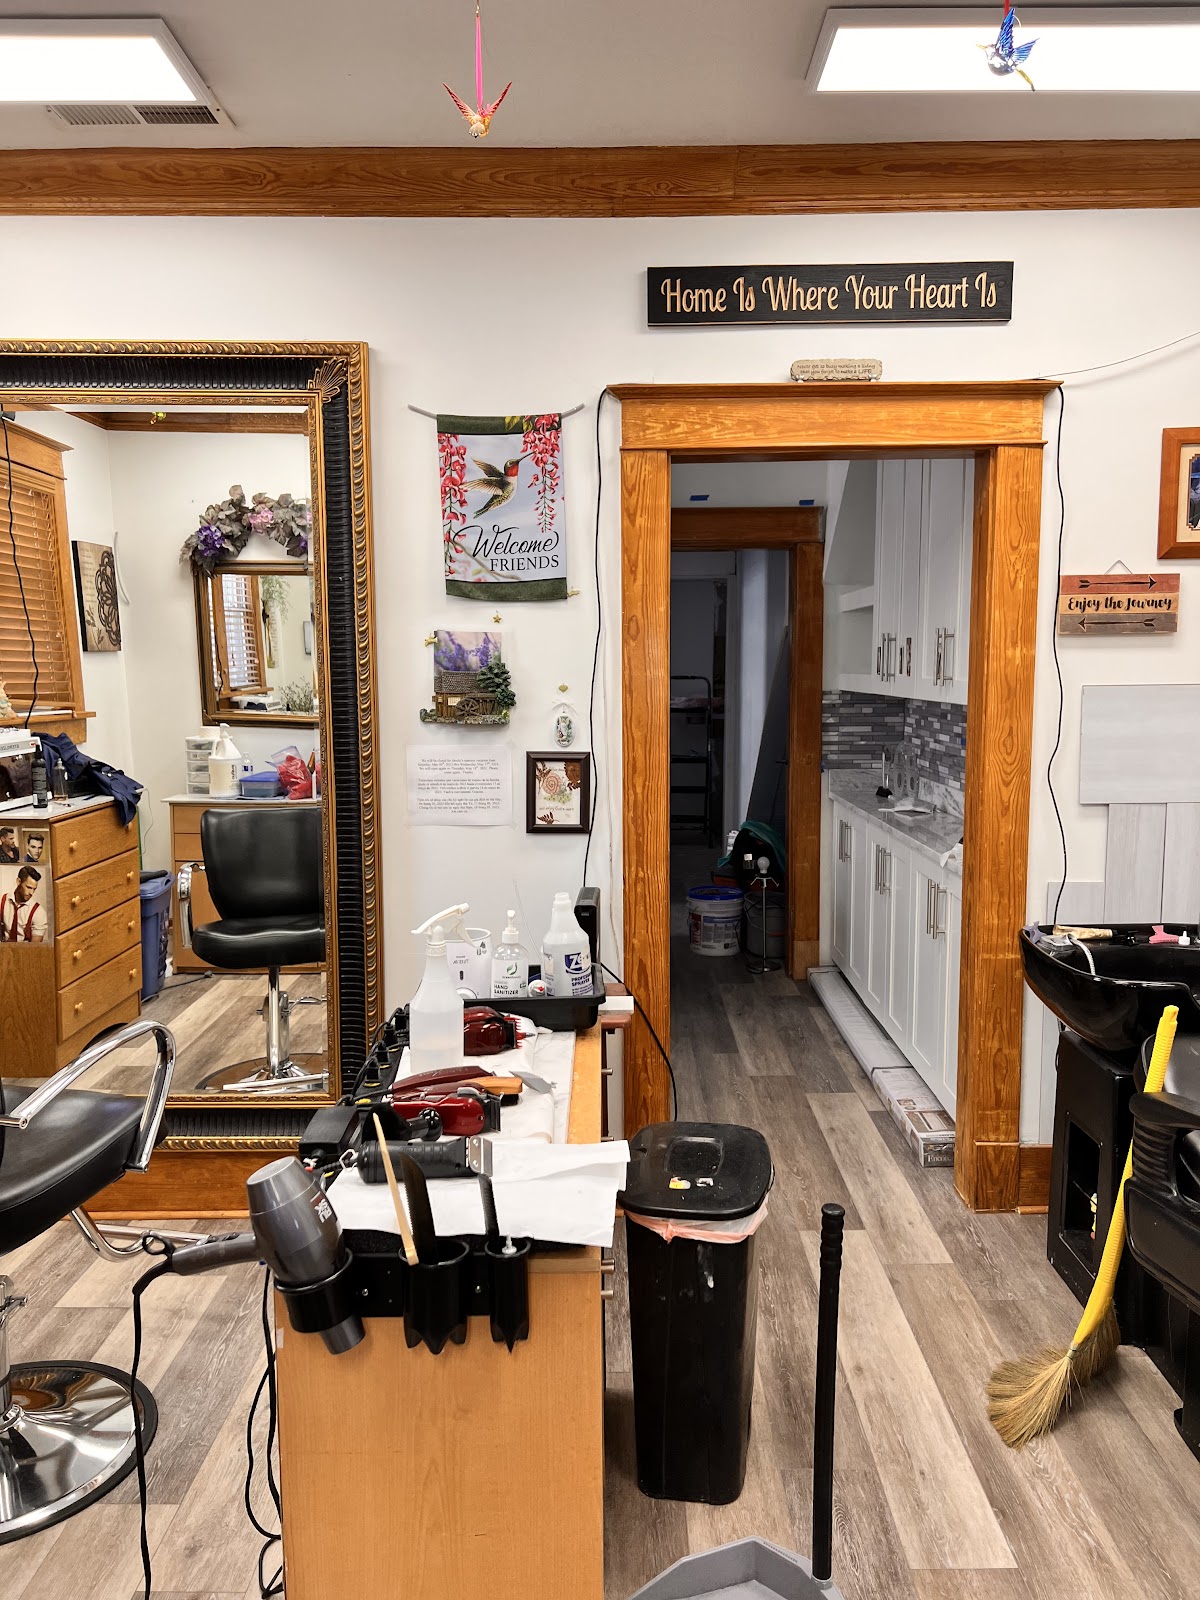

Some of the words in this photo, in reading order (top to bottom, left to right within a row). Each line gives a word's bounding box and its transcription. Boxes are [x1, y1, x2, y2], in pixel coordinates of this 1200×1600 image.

[660, 277, 727, 313] Home
[732, 276, 756, 312] Is
[761, 275, 839, 311] Where
[845, 273, 898, 310] Your
[904, 272, 969, 309] Heart
[974, 271, 997, 308] Is
[452, 524, 559, 558] Welcome
[490, 554, 559, 572] FRIENDS
[1067, 596, 1102, 613] Enjoy
[1104, 596, 1123, 610] the
[1125, 597, 1172, 611] Journey
